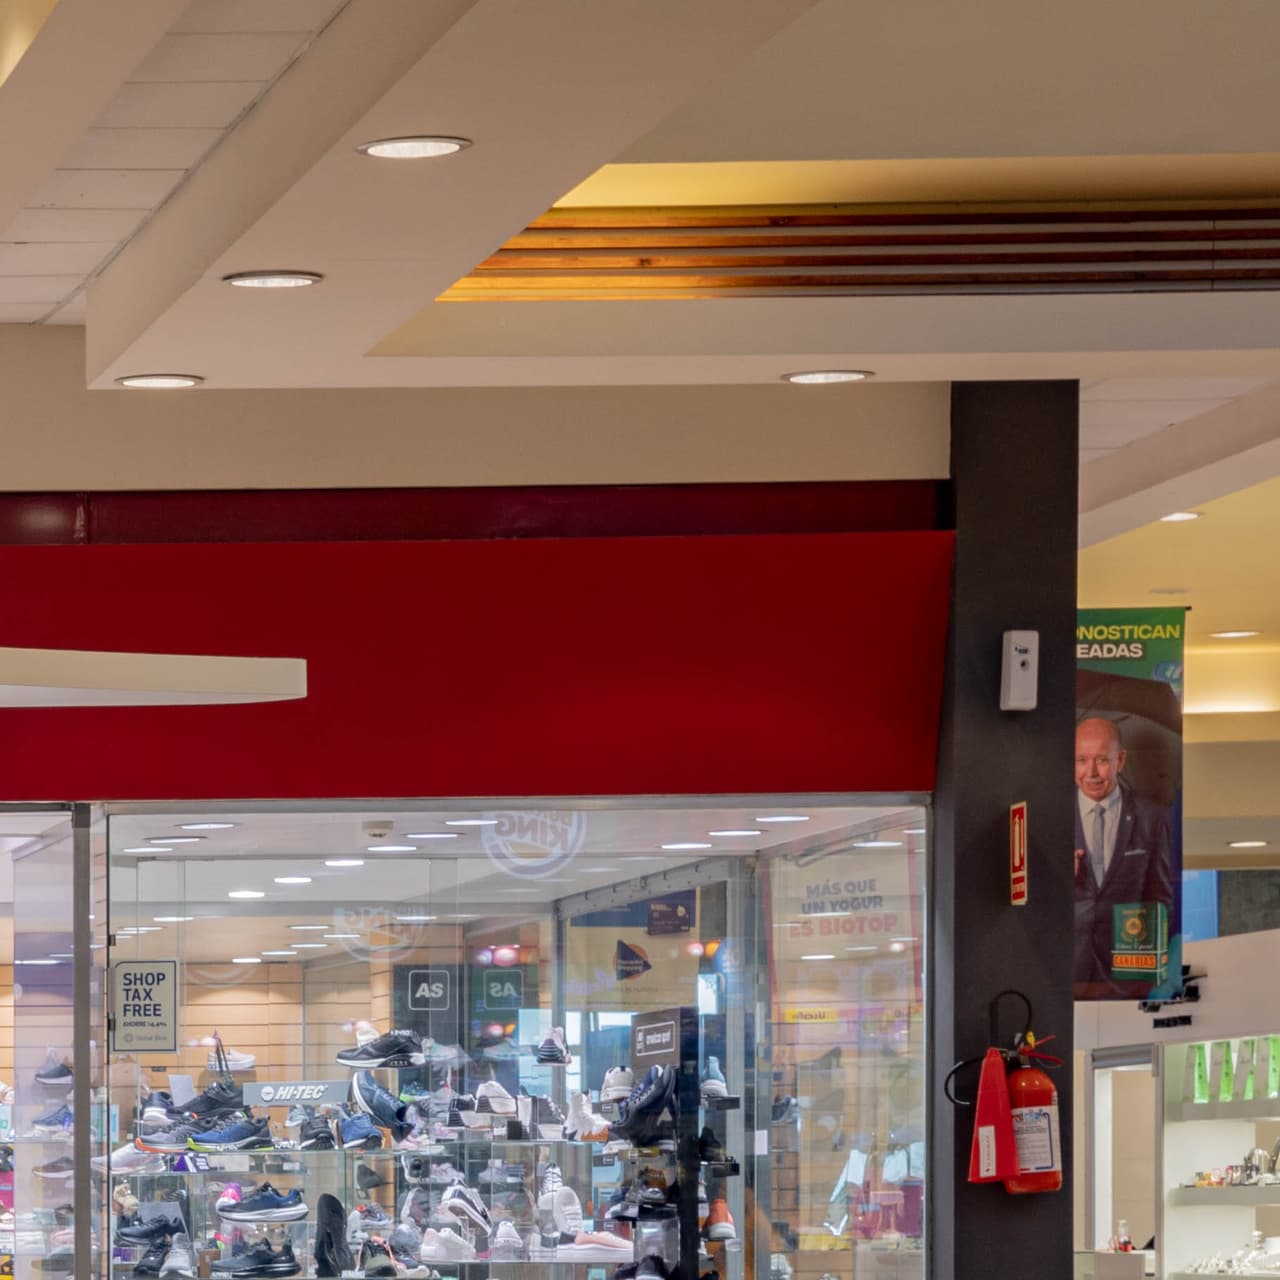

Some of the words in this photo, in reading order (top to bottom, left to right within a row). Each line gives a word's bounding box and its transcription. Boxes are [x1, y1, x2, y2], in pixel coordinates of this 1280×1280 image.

[1075, 624, 1180, 640] NOSTICAN
[122, 972, 166, 987] SHOP
[122, 988, 153, 1002] TAX
[415, 982, 444, 998] AS
[122, 1003, 162, 1017] FREE
